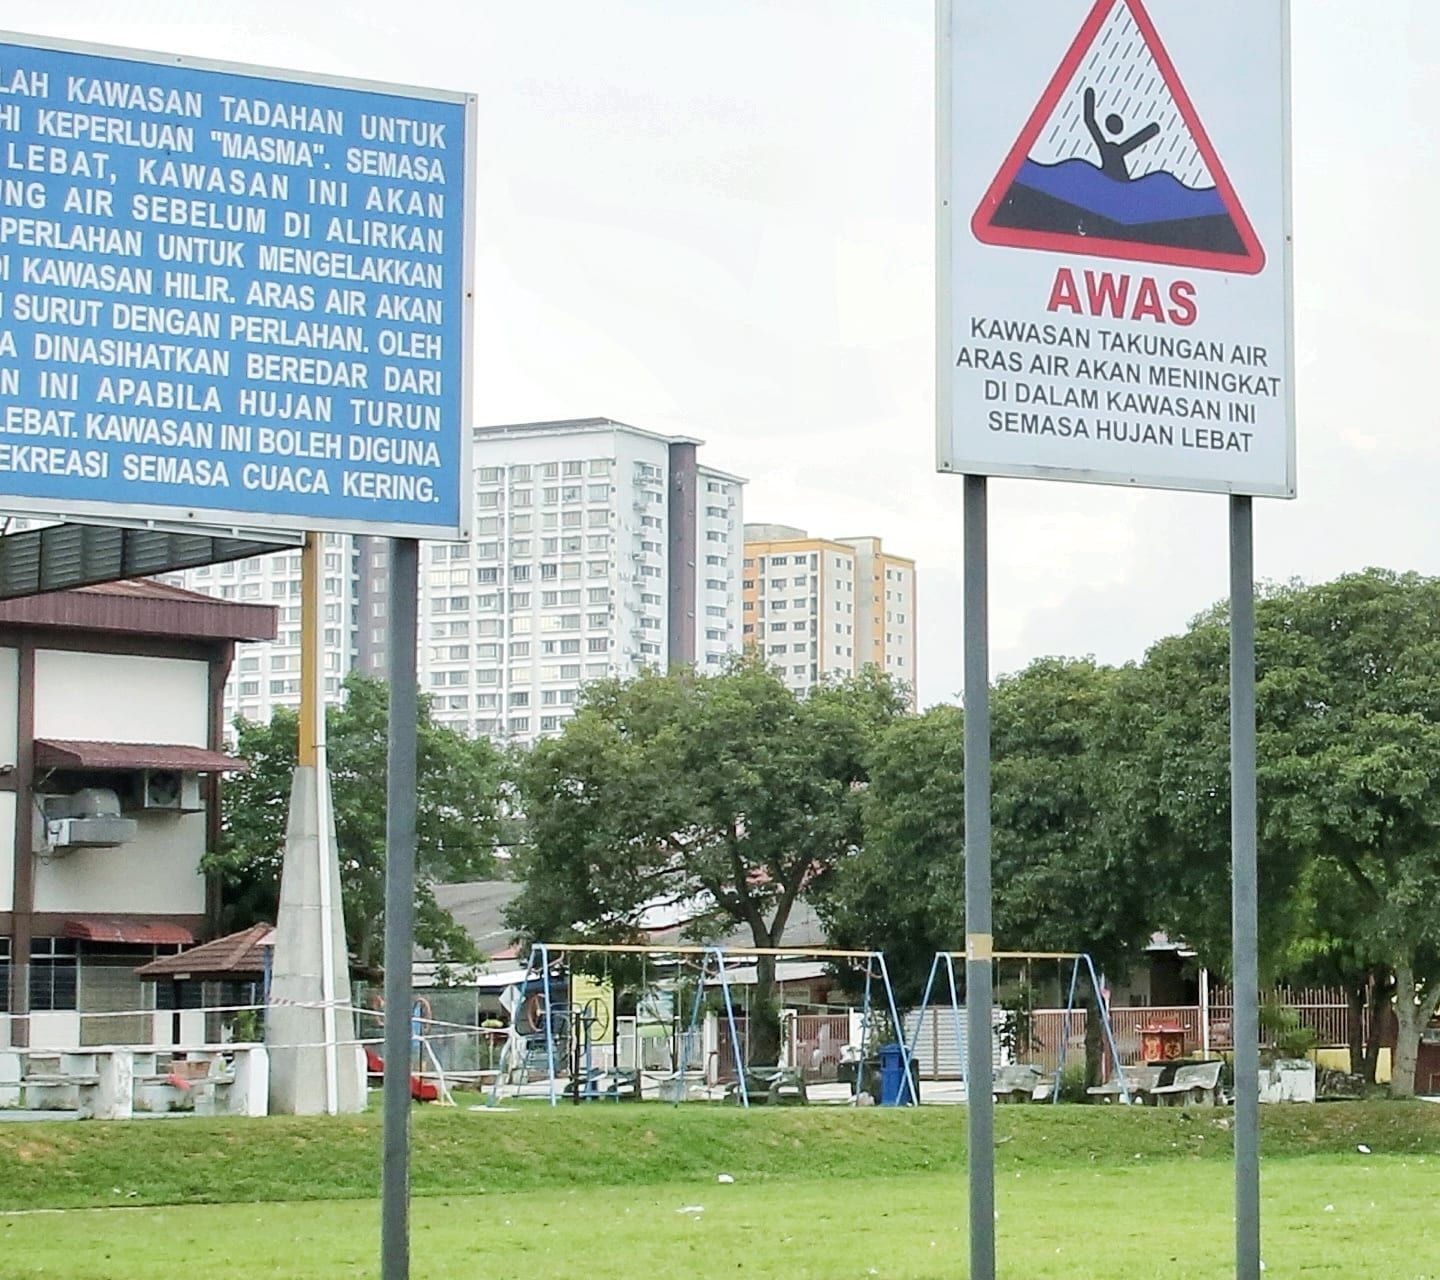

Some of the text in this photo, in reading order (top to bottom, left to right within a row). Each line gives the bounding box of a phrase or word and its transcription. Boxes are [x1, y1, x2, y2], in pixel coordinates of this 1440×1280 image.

[67, 76, 202, 118] KAWASAN
[219, 95, 343, 135] TADAHAN
[361, 114, 446, 149] UNTUK
[38, 109, 193, 153] KEPERLUAN
[210, 130, 330, 170] "MASMA".
[346, 148, 445, 184] SEMASA
[7, 142, 116, 185] LEBAT,
[139, 158, 288, 200] KAWASAN
[309, 178, 347, 207] INI
[365, 186, 444, 219] AKAN
[63, 187, 113, 217] AIR
[132, 194, 266, 234] SEBELUM
[284, 211, 310, 239] DI
[326, 217, 443, 254] ALIRKAN
[0, 217, 142, 257] PERLAHAN
[158, 233, 244, 268] UNTUK
[259, 245, 442, 290] MENGELAKKAN
[23, 257, 152, 295] KAWASAN
[165, 271, 236, 304] HILIR.
[246, 280, 315, 311] ARAS
[324, 288, 366, 317] AIR
[375, 294, 442, 325] AKAN
[1046, 267, 1197, 326] AWAS
[13, 293, 103, 327] SURUT
[112, 303, 220, 339] DENGAN
[230, 314, 369, 353] PERLAHAN.
[378, 330, 442, 361] OLEH
[971, 317, 1268, 367] KAWASAN TAKUNGAN AIR
[34, 333, 229, 377] DINASIHATKAN
[247, 352, 368, 389] BEREDAR
[384, 366, 441, 396] DARI
[956, 346, 1281, 397] ARAS AIR AKAN MENINGKAT
[40, 371, 78, 401] INI
[96, 377, 222, 413] APABILA
[239, 389, 331, 422] HUJAN
[350, 399, 441, 432] TURUN
[985, 379, 1256, 424] DI DALAM KAWASAN INI
[988, 410, 1253, 453] SEMASA HUJAN LEBAT
[86, 413, 213, 449] KAWASAN
[220, 424, 252, 452] INI
[258, 427, 342, 459] BOLEH
[349, 435, 441, 468] DIGUNA
[122, 453, 230, 487] SEMASA
[242, 463, 330, 495] CUACA
[343, 470, 439, 503] KERING.
